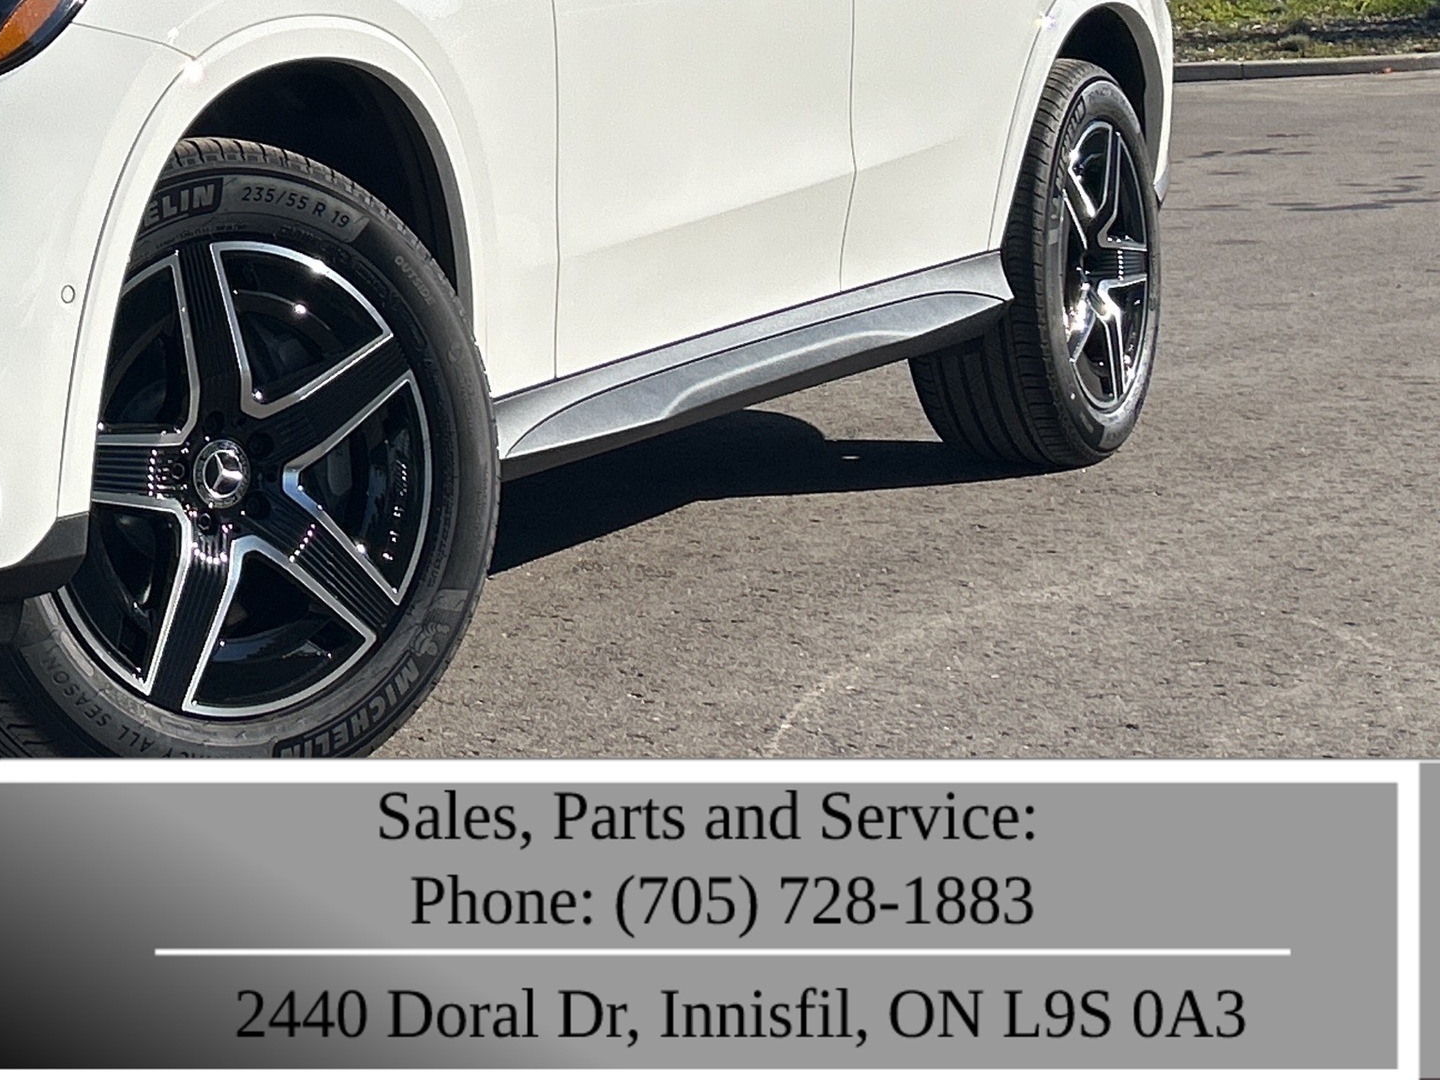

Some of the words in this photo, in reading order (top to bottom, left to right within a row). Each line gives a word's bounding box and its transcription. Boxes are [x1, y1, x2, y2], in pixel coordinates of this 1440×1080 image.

[144, 184, 215, 227] ELIN
[241, 186, 308, 210] 235/55
[312, 203, 327, 218] R
[331, 209, 350, 228] 19
[394, 255, 437, 306] OUTSIDE
[41, 656, 111, 726] SEASON
[117, 725, 155, 753] ALL
